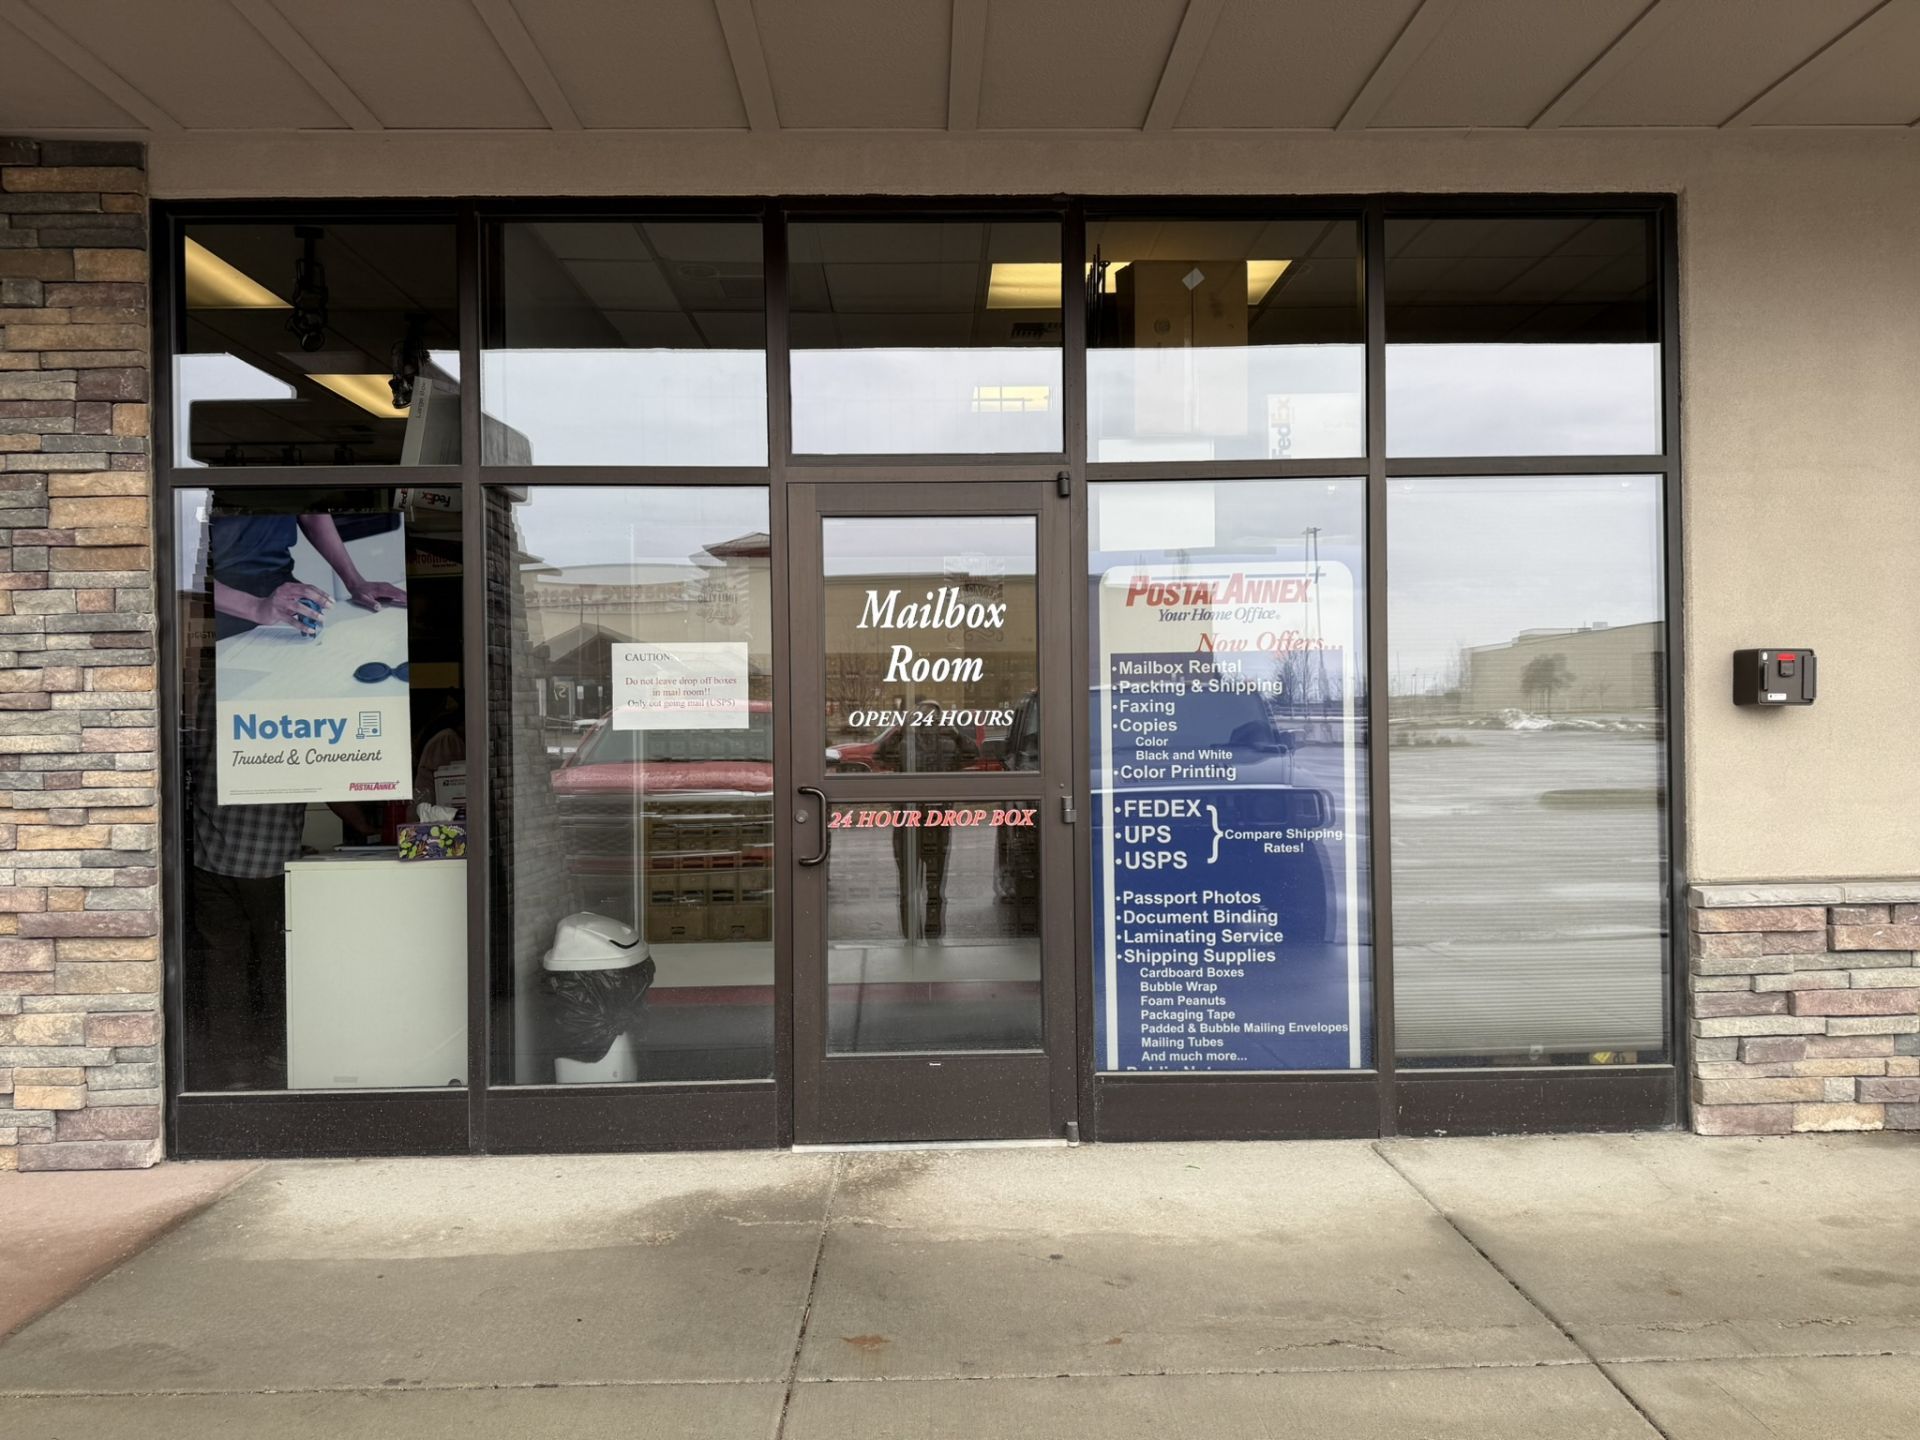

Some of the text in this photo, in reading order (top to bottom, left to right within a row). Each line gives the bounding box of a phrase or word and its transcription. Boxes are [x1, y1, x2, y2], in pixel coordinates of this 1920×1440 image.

[422, 492, 451, 508] FedEx
[856, 587, 1006, 629] Mailbox
[1159, 608, 1190, 622] Your
[1191, 608, 1232, 621] Home
[1195, 633, 1248, 654] Now
[884, 645, 984, 682] Room
[1120, 660, 1242, 674] Mailbox Rental
[679, 677, 698, 686] drop
[1120, 678, 1283, 696] Packing & Shipping
[628, 700, 645, 709] Only
[1120, 699, 1175, 715] Faxing
[849, 709, 1014, 727] OPEN 24 HOURS
[233, 714, 347, 744] Notary
[1120, 718, 1178, 735] Copies
[1136, 736, 1168, 746] Color
[232, 748, 382, 766] Trusted & Convenient
[1136, 749, 1233, 760] Black and White
[1120, 764, 1236, 781] Color Printing
[1124, 799, 1202, 818] FEDEX
[828, 809, 1037, 828] 24 HOUR DROP BOX
[1124, 826, 1172, 844] UPS
[1224, 827, 1343, 842] Compare Shipping
[1264, 842, 1304, 853] Rates!
[1124, 851, 1188, 870] USPS
[1123, 890, 1261, 907] Passport Photos
[1124, 909, 1278, 926] Document Binding
[1124, 929, 1283, 946] Laminating Service
[1124, 949, 1276, 965] Shipping Supplies
[1140, 967, 1244, 978] Cardboard Boxes
[1140, 982, 1217, 994] Bubble Wrap
[1141, 995, 1226, 1006] Foam Peanuts
[1141, 1010, 1235, 1022] Packaging Tape
[1141, 1022, 1348, 1035] Padded & Bubble Mailing Envelopes
[1141, 1037, 1224, 1049] Mailing Tubes
[1142, 1051, 1166, 1061] And
[1170, 1051, 1202, 1061] much
